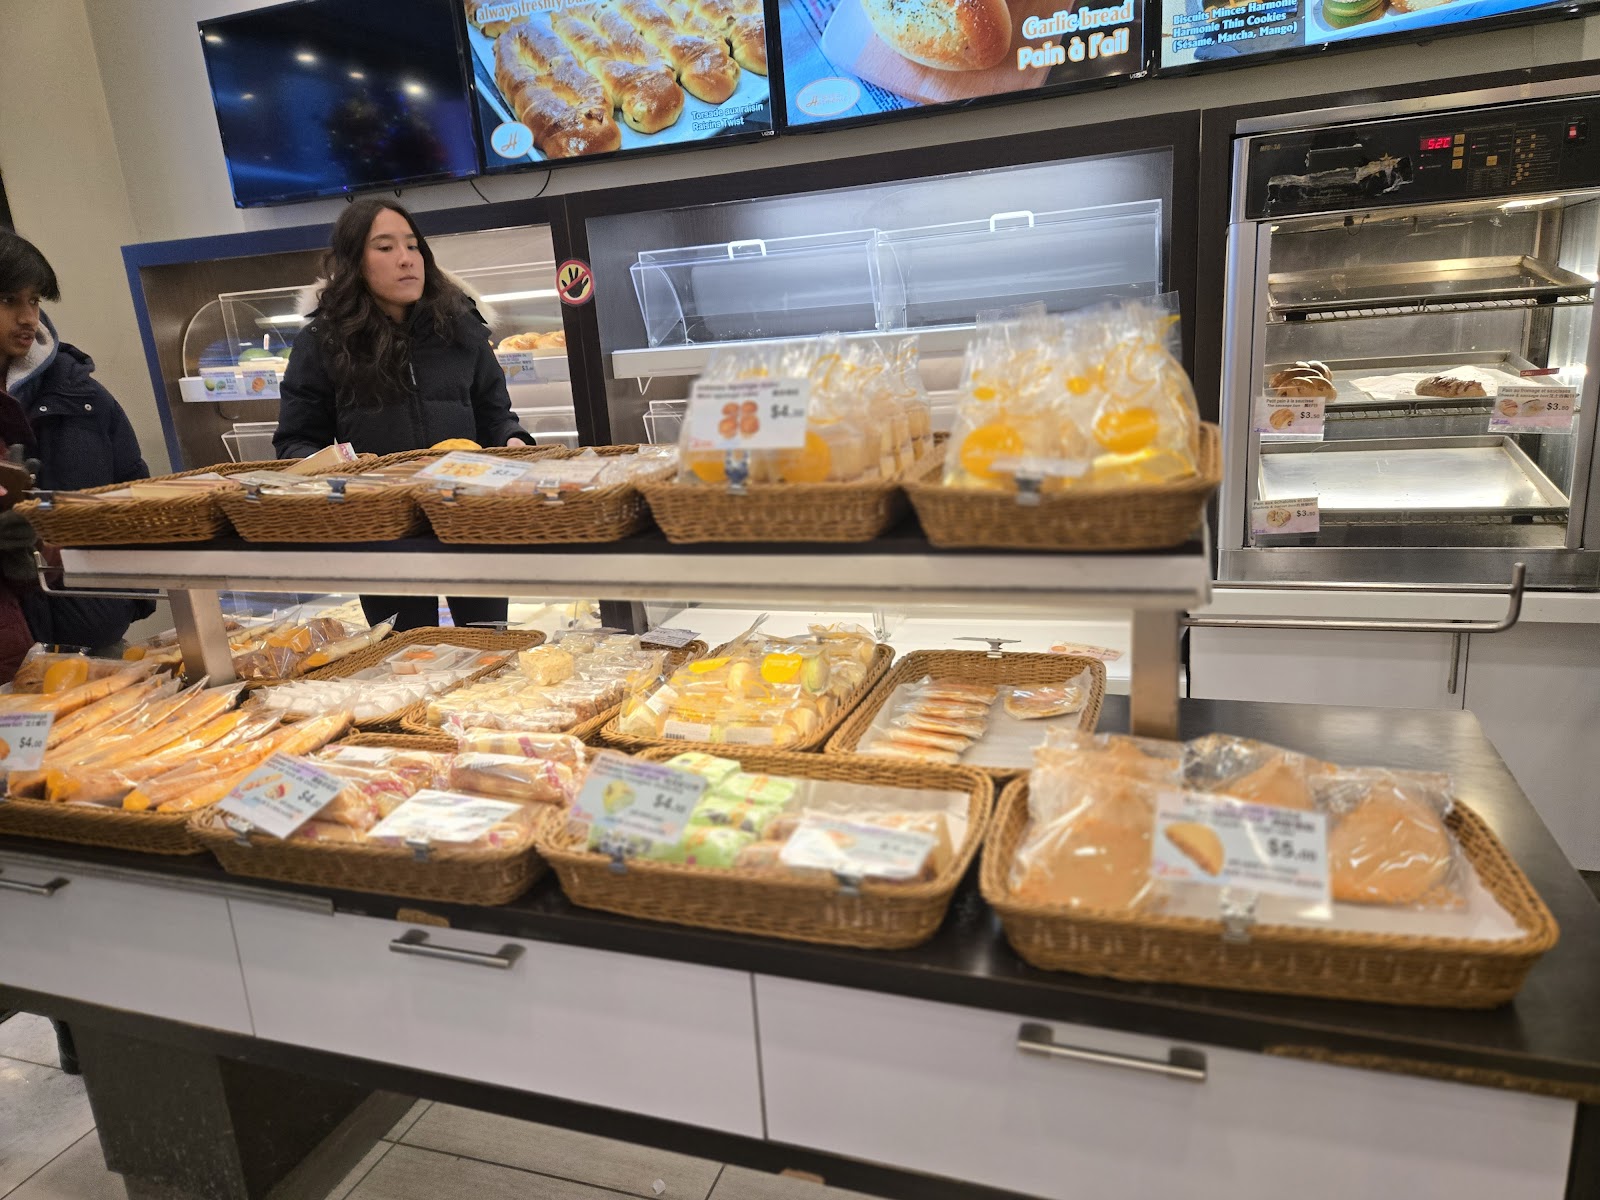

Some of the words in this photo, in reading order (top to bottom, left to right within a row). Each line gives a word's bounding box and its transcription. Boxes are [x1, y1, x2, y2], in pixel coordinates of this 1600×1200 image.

[478, 3, 518, 21] always
[1024, 12, 1077, 37] Garlic
[1080, 2, 1132, 28] bread
[1173, 11, 1210, 25] Biscuits
[1212, 5, 1247, 19] Minces
[1173, 22, 1221, 38] Harmonie
[1222, 17, 1245, 31] Thin
[1247, 12, 1287, 26] Cookies
[1218, 30, 1257, 44] Matcha,
[1260, 22, 1298, 37] Mango)
[1017, 41, 1065, 71] Pain
[1068, 36, 1085, 62] à
[692, 108, 723, 120] Torsade
[724, 104, 740, 117] aux
[741, 101, 764, 114] raisin
[692, 120, 722, 132] Raisins
[722, 116, 745, 129] Twist
